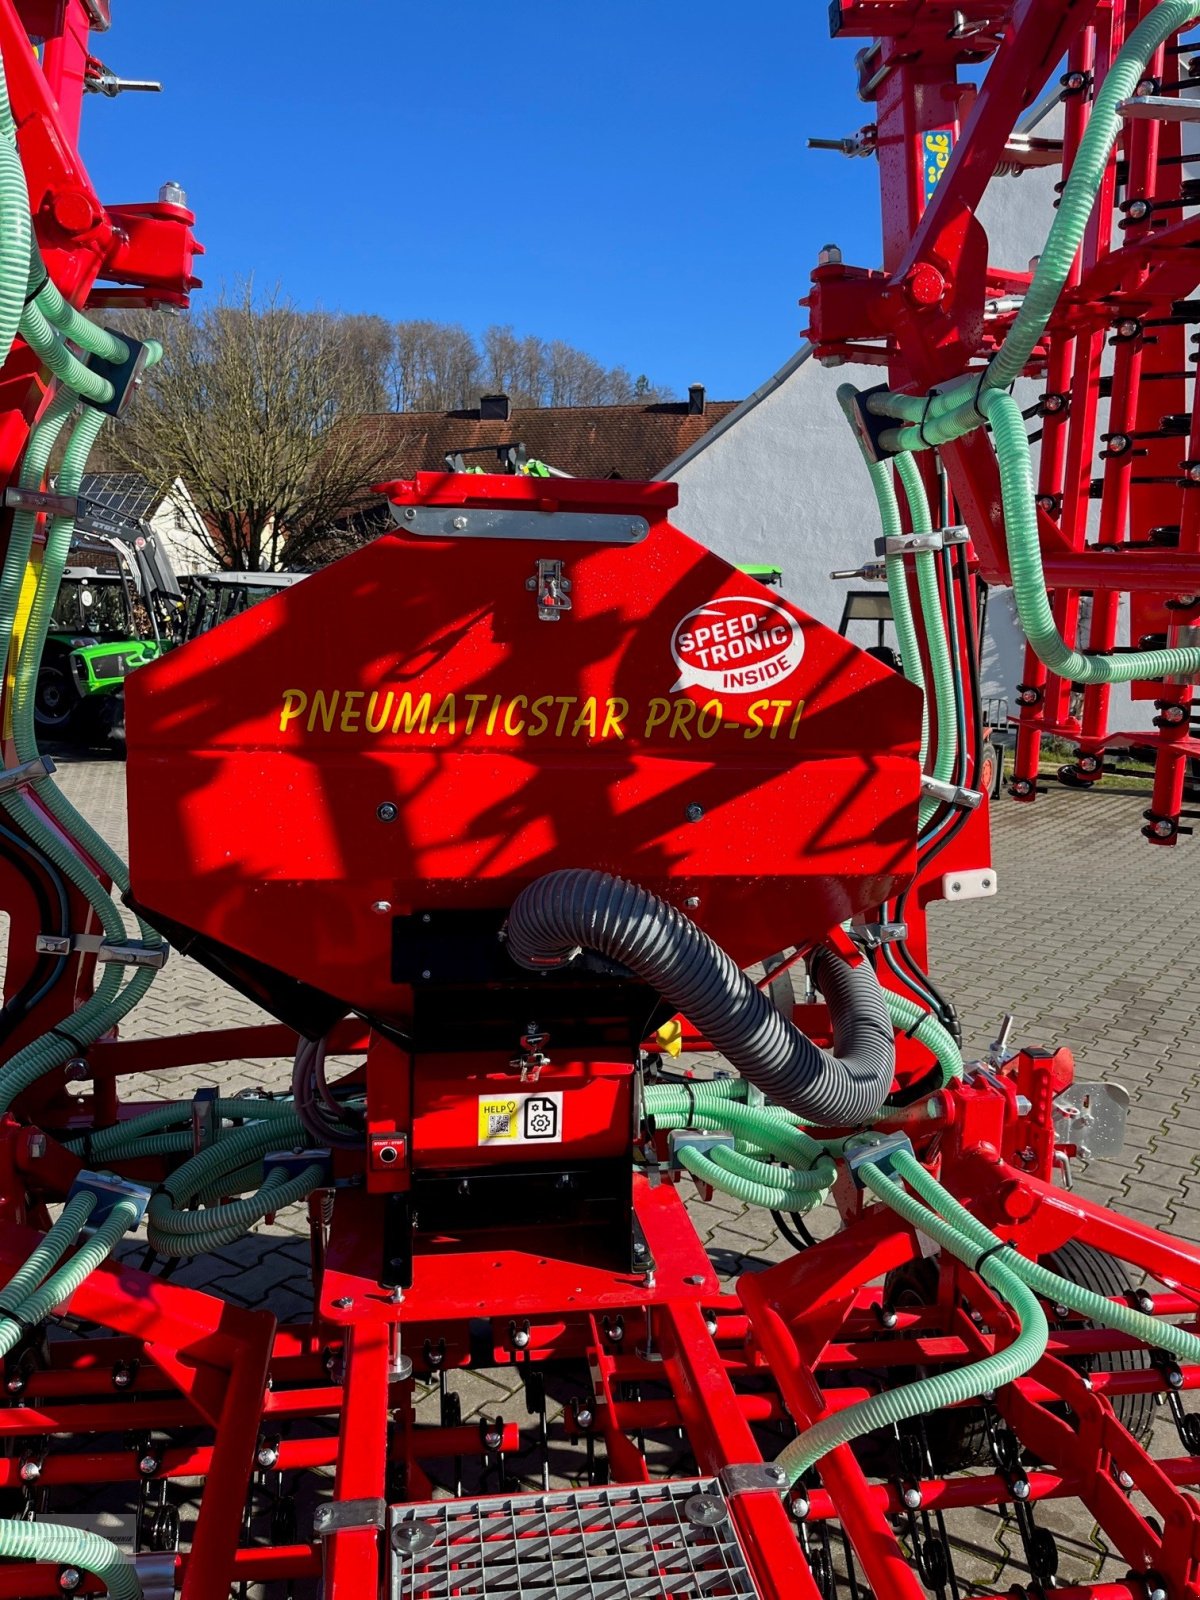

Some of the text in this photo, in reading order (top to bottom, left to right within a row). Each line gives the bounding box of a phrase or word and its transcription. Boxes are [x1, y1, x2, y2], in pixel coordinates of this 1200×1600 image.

[678, 613, 767, 652] SPEED-
[695, 626, 788, 668] TRONIC
[723, 654, 792, 689] INSIDE
[279, 689, 805, 741] PNEUMATICSTAR PRO-STI
[484, 1105, 507, 1113] HELP
